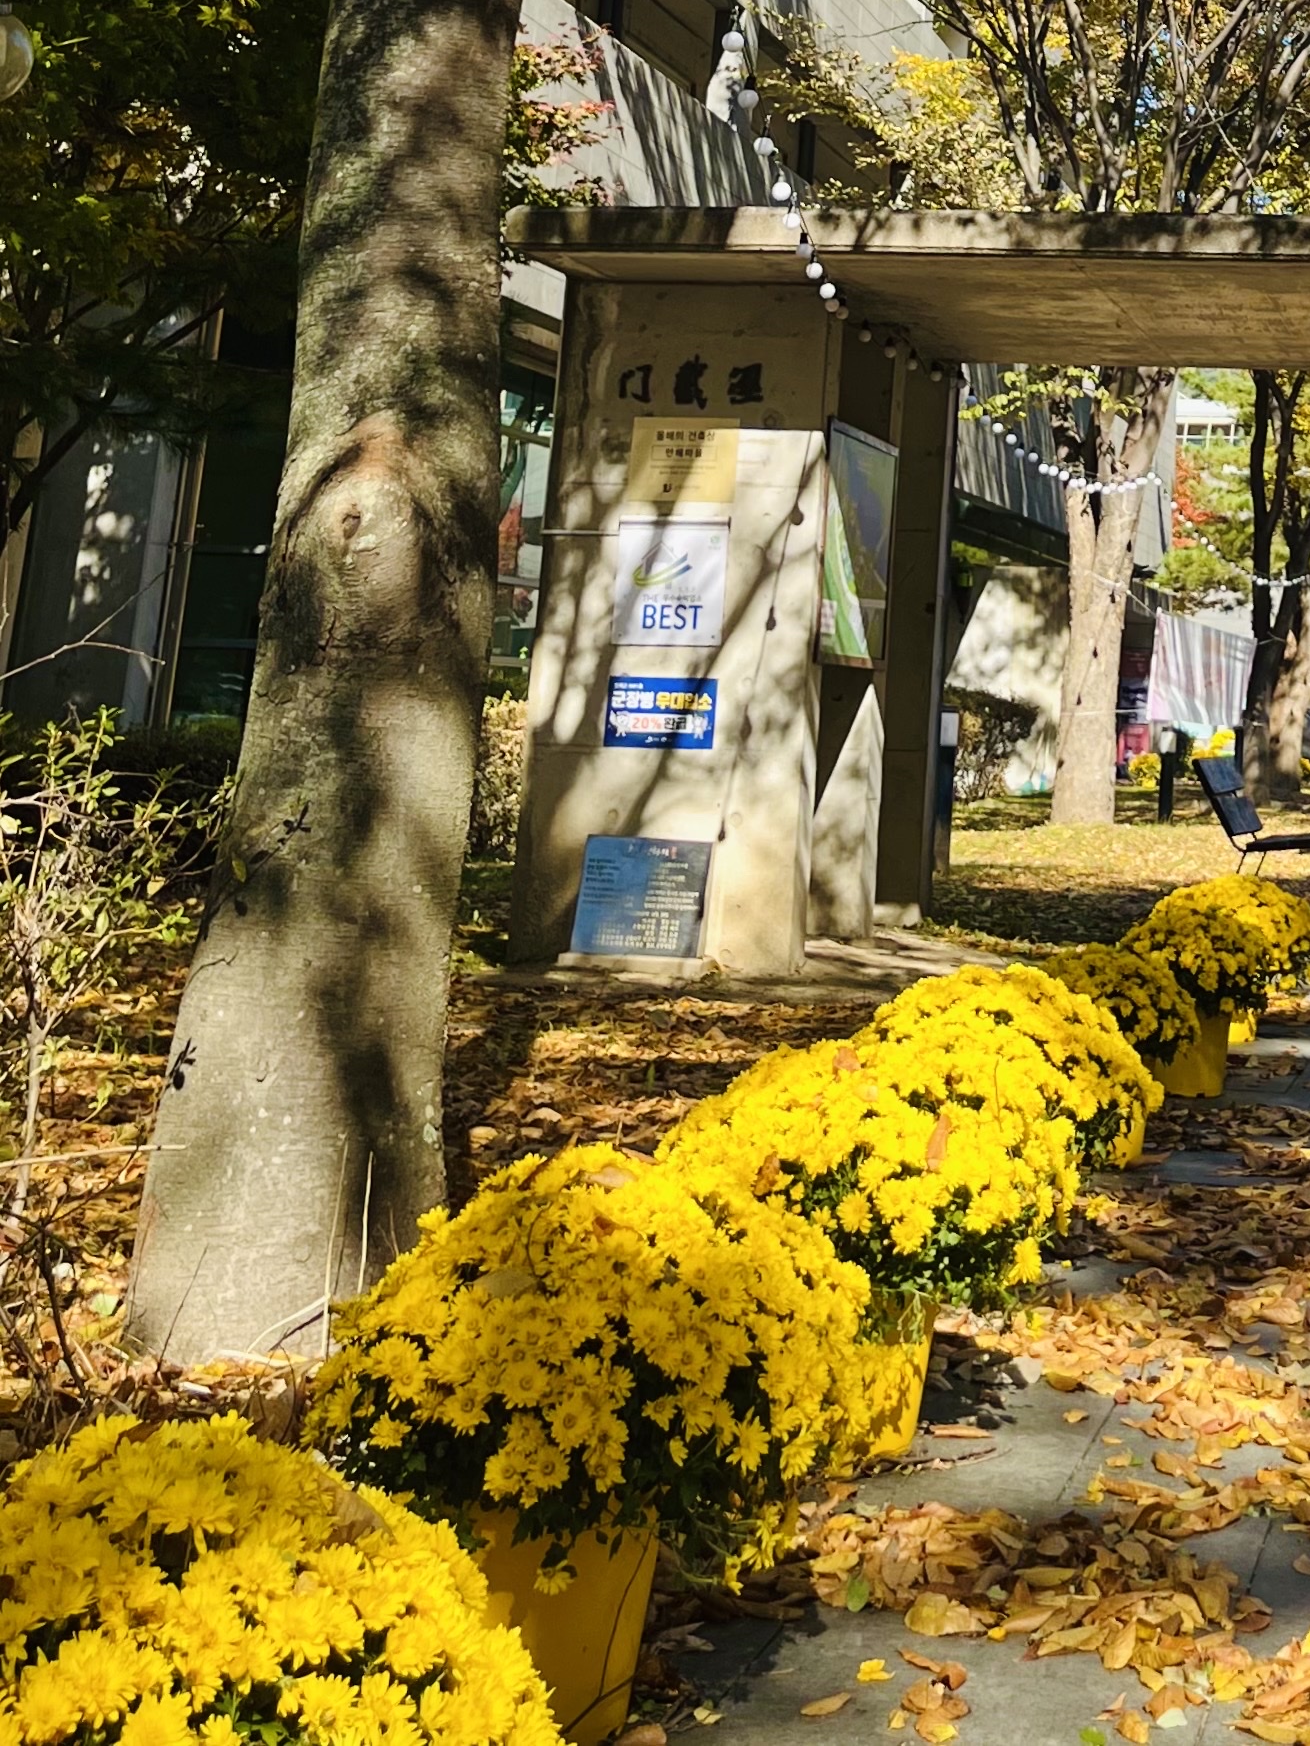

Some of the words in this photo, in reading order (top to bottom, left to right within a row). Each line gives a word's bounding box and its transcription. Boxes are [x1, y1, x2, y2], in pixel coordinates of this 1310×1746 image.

[642, 604, 703, 630] BEST
[611, 690, 655, 710] 군장병
[655, 691, 713, 712] 우대업소
[631, 717, 662, 729] 20%
